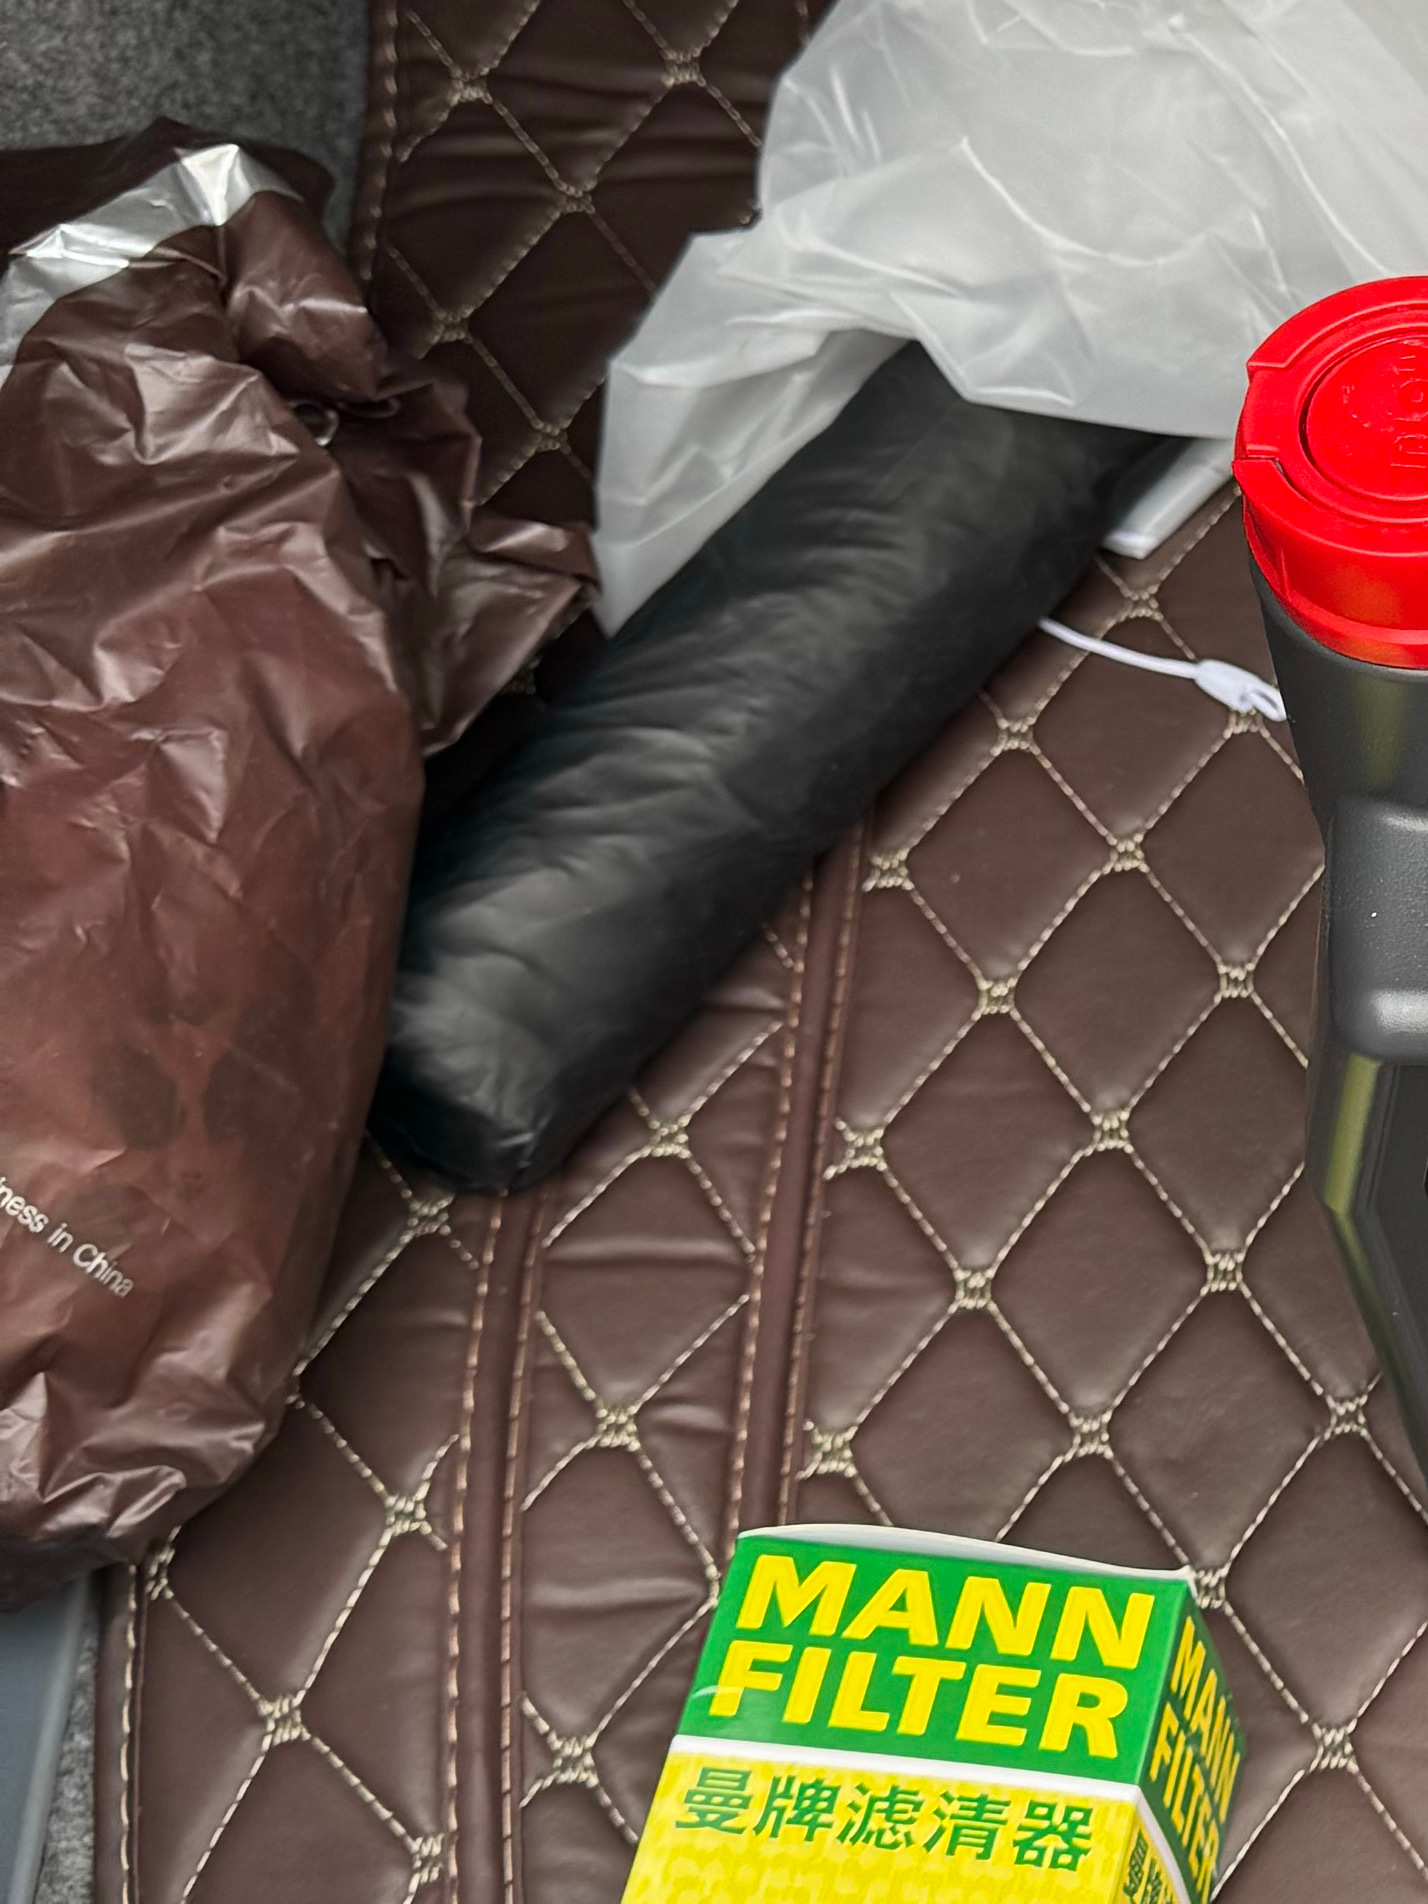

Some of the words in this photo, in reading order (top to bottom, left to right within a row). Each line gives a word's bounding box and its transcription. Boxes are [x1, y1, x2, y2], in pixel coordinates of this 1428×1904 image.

[47, 1222, 73, 1253] in
[73, 1243, 133, 1298] China
[735, 1554, 1155, 1670] MANN
[708, 1639, 1129, 1759] FILTER
[1170, 1616, 1241, 1825] MANN
[675, 1766, 1094, 1872] 曼牌滤清器
